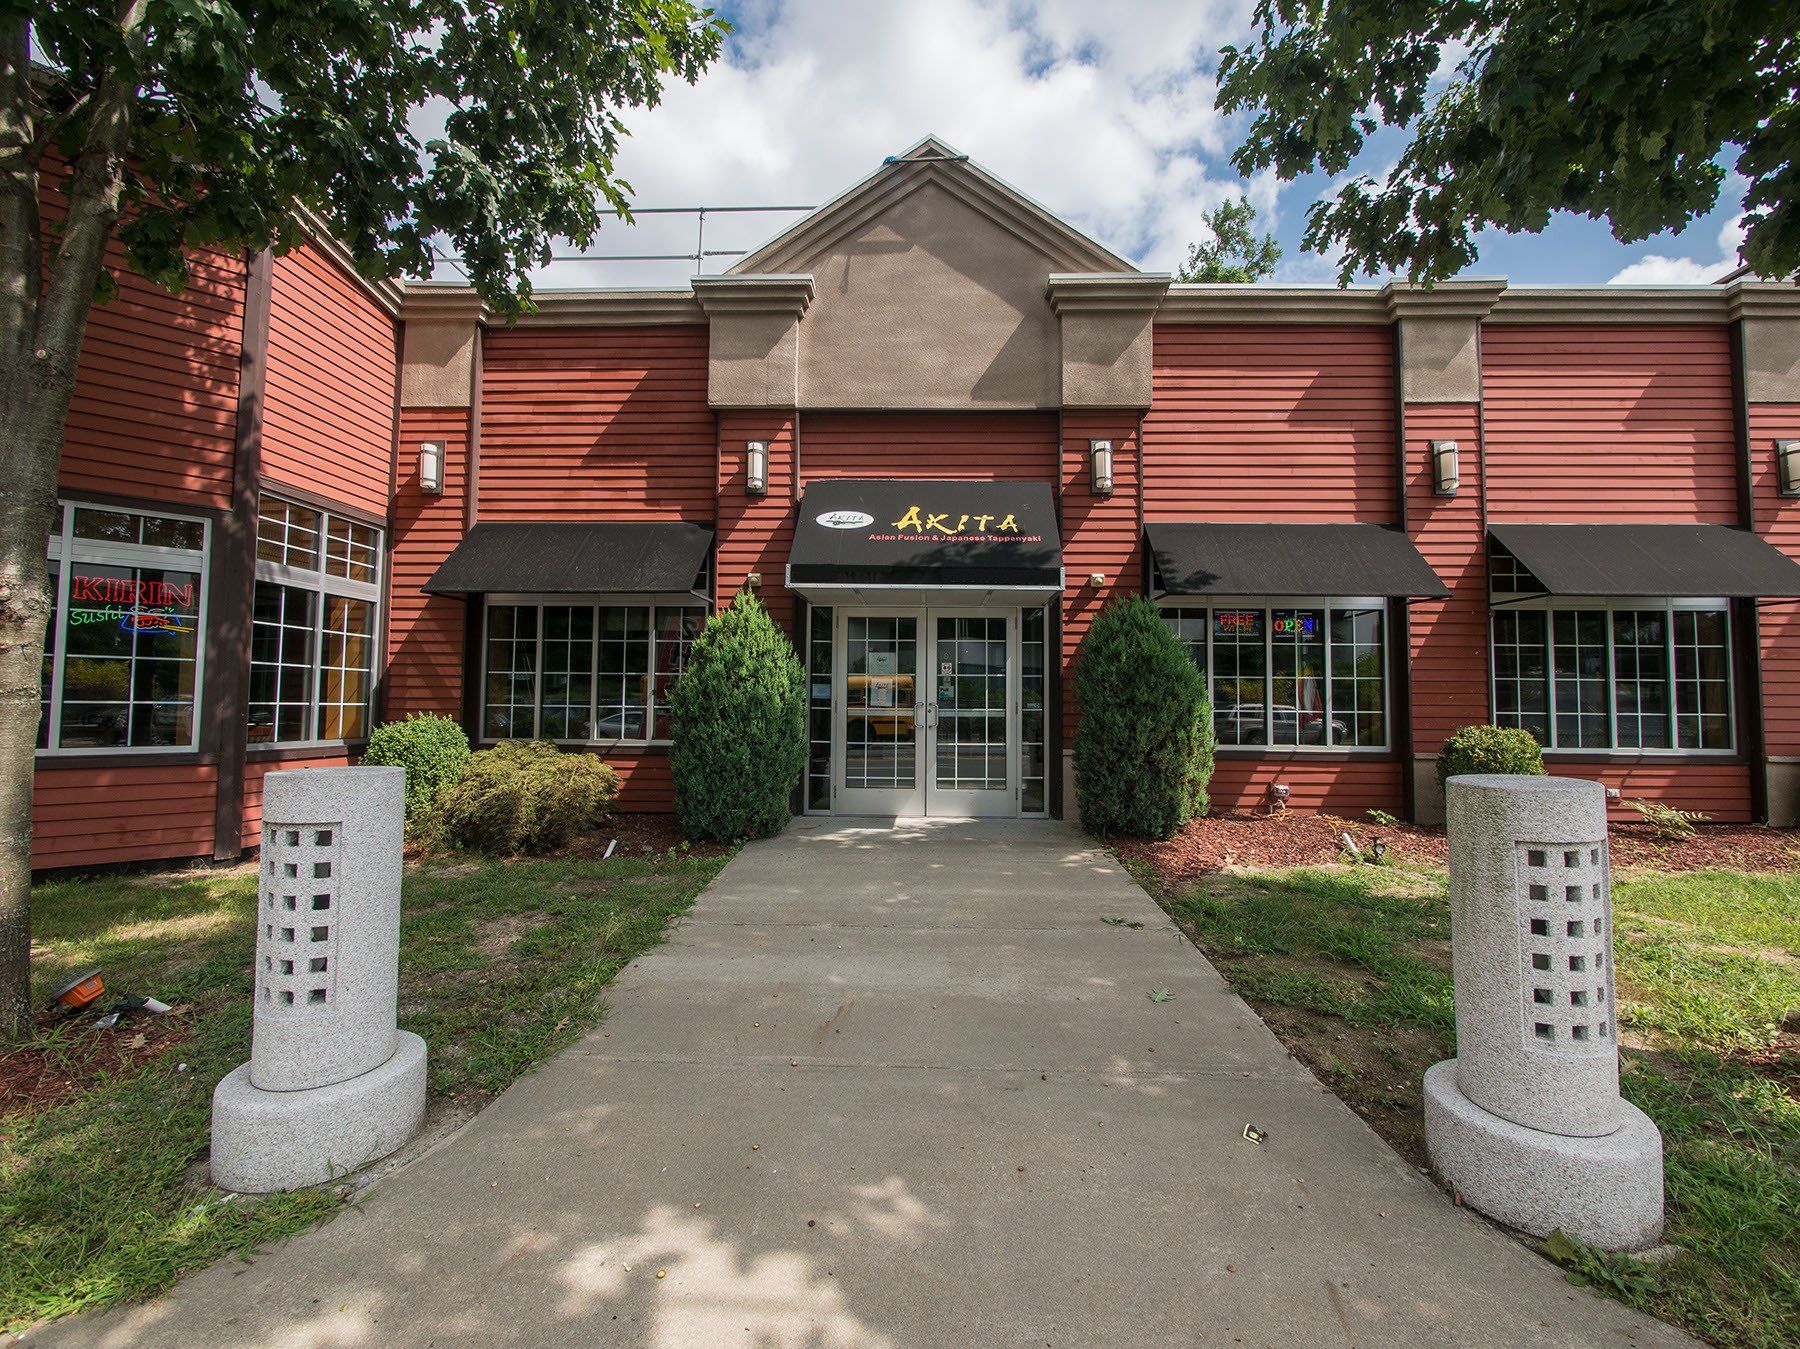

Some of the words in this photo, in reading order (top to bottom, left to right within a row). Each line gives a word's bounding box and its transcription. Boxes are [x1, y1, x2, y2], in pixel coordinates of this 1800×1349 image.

[891, 506, 1020, 535] AKITA
[869, 533, 896, 541] Asian
[898, 533, 930, 541] Fusion
[941, 534, 985, 543] Japanese
[987, 534, 1041, 543] Tappanyaki
[72, 575, 194, 607] KIRIN
[70, 604, 125, 626] Sushi
[1273, 618, 1314, 632] OPEN
